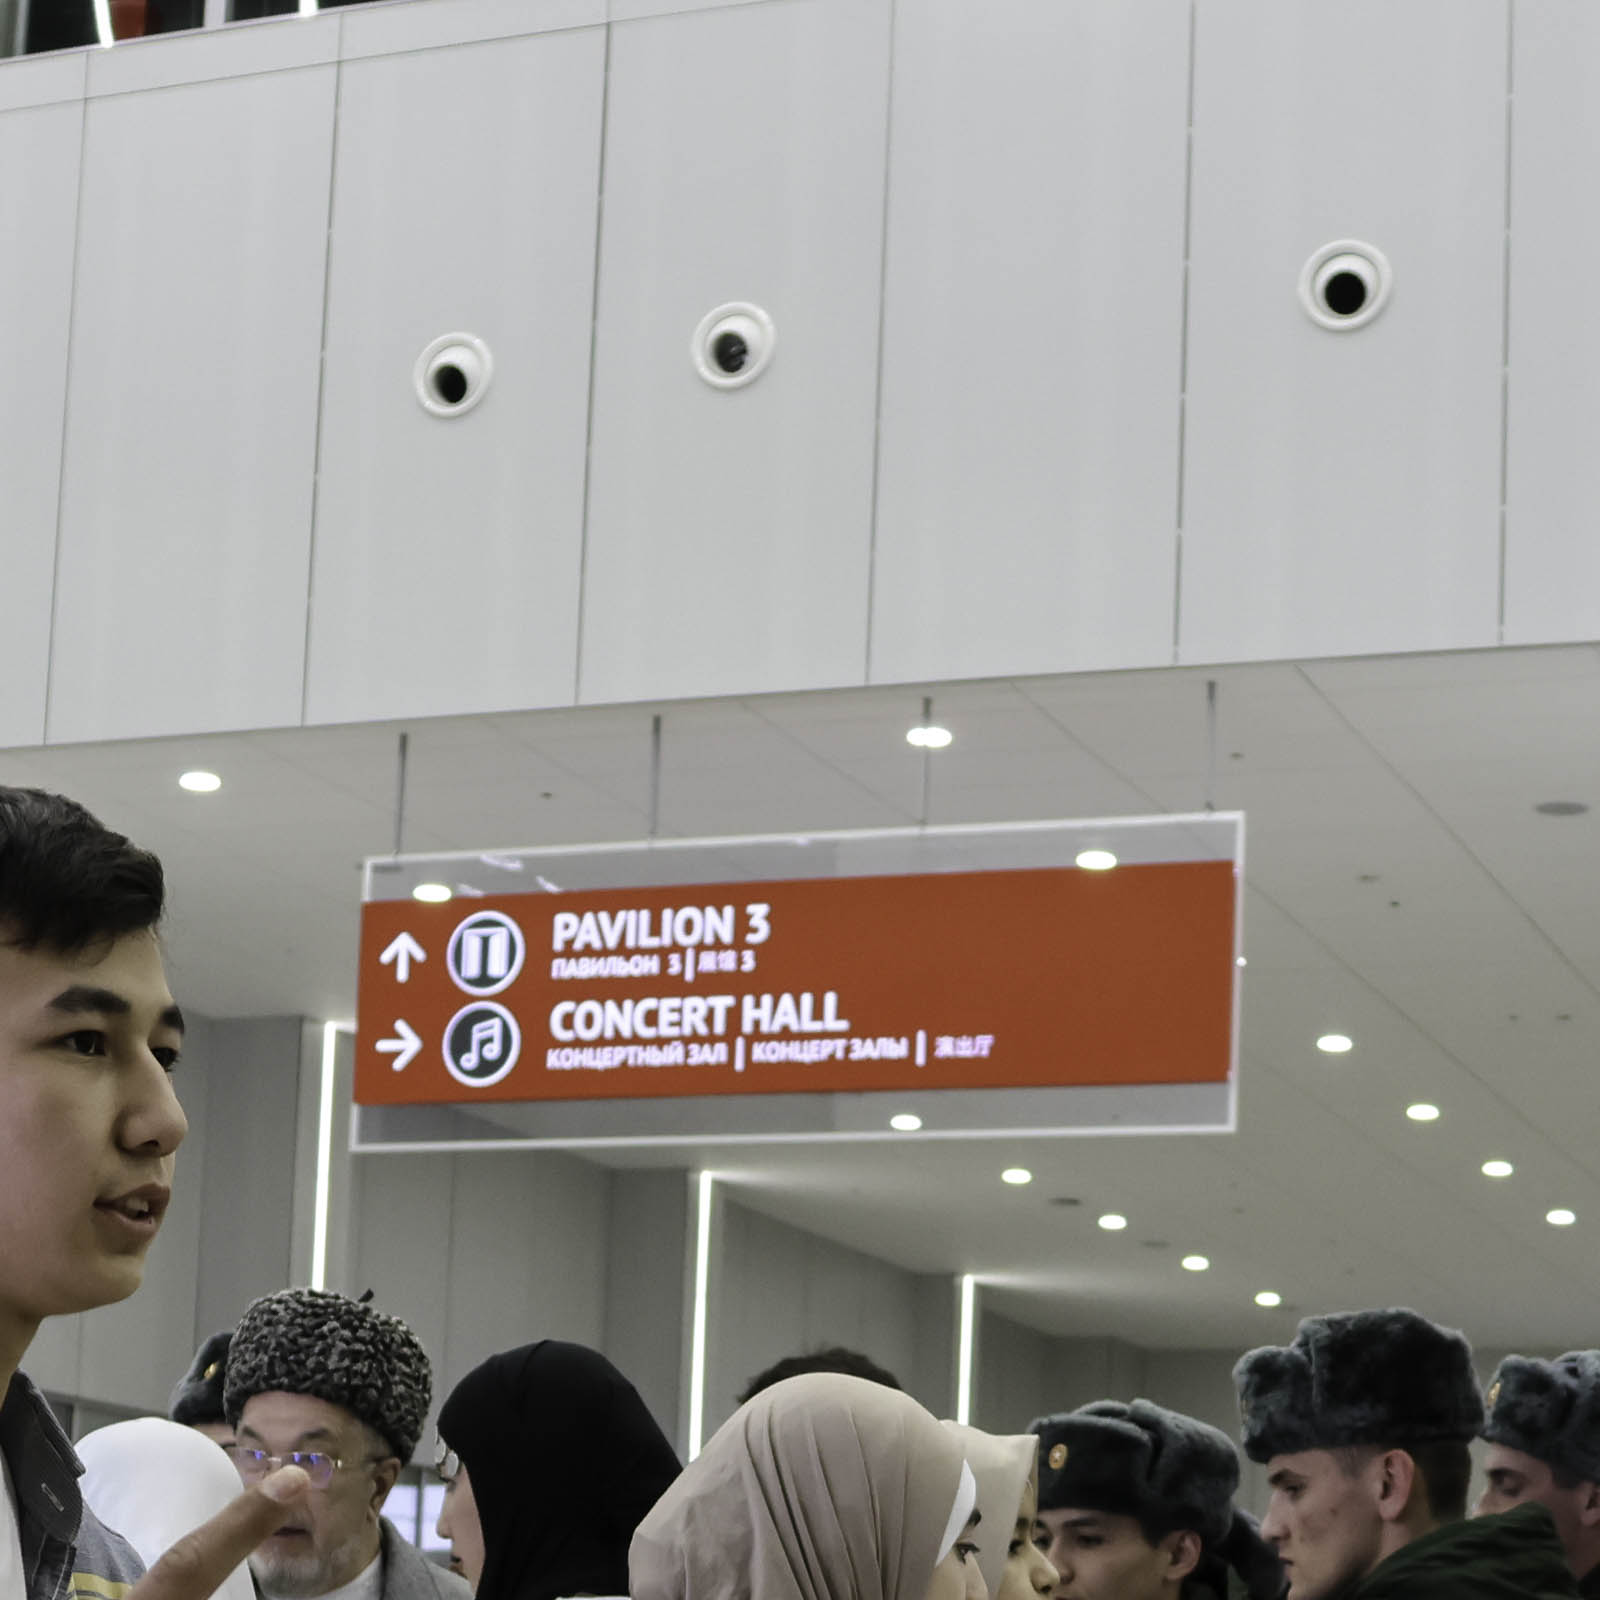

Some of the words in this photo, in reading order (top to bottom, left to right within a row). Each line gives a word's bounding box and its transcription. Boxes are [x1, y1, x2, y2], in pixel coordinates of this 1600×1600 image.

[552, 904, 735, 952] PAVILION
[745, 903, 771, 944] 3
[551, 954, 661, 980] ПАВИЛЬОН
[667, 953, 683, 976] 3
[740, 949, 756, 972] 3
[550, 995, 737, 1042] CONCERT
[741, 991, 851, 1034] HALL
[546, 1040, 686, 1071] КОНЦЕРТНЫЙ
[687, 1042, 729, 1066] ЗАЛ
[751, 1038, 848, 1064] КОНЦЕРТ
[848, 1036, 909, 1060] ЗАЛЫ
